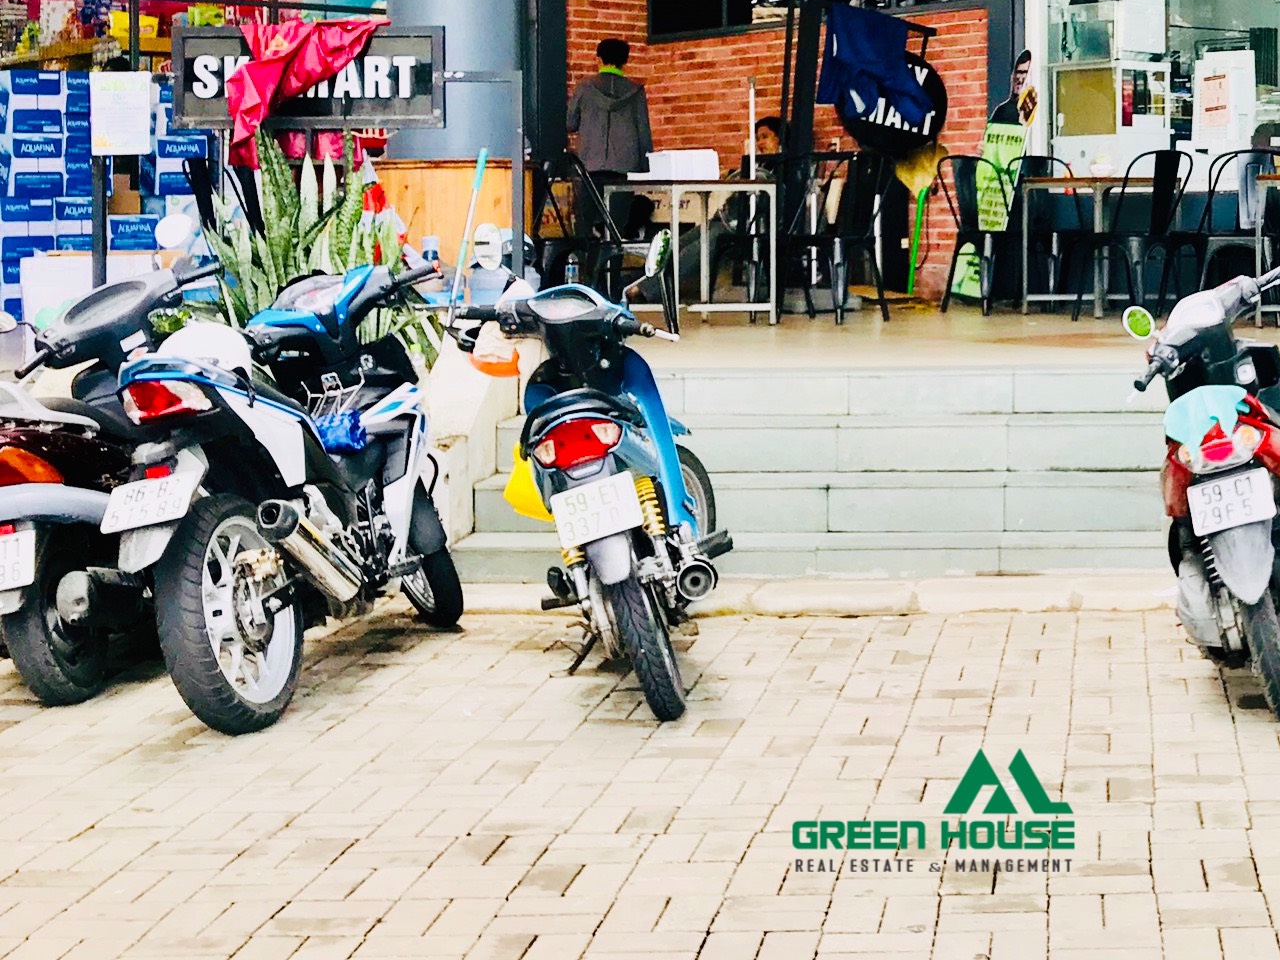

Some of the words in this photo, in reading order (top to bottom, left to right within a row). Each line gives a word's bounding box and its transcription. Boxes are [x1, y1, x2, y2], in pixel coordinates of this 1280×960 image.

[20, 143, 56, 154] AQUAFINA
[165, 143, 200, 154] AQUAFINA
[64, 205, 92, 217] AQUAFI
[117, 223, 151, 234] AQUAFINA
[1200, 476, 1254, 505] 59-C1
